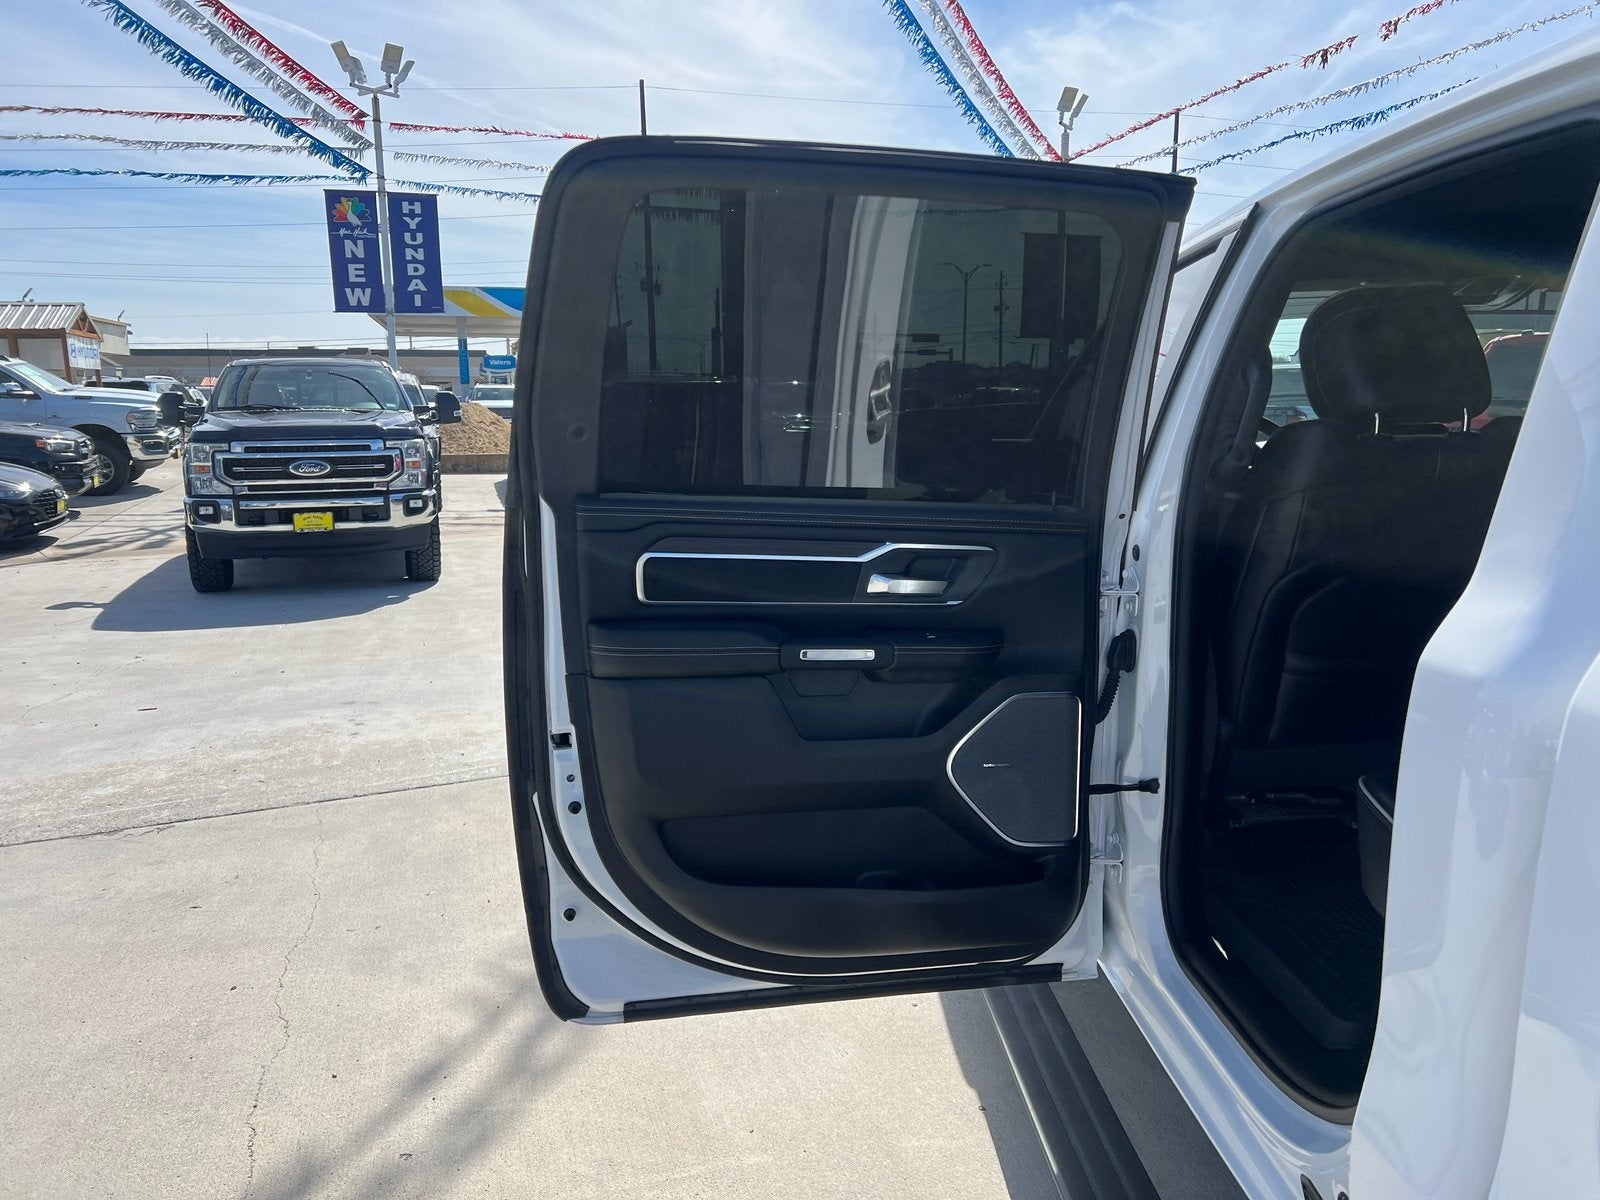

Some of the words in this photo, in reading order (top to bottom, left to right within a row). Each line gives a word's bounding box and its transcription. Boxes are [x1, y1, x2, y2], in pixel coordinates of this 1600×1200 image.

[344, 239, 372, 307] NEW
[401, 201, 428, 307] HYUNDAI
[298, 463, 321, 473] Ford
